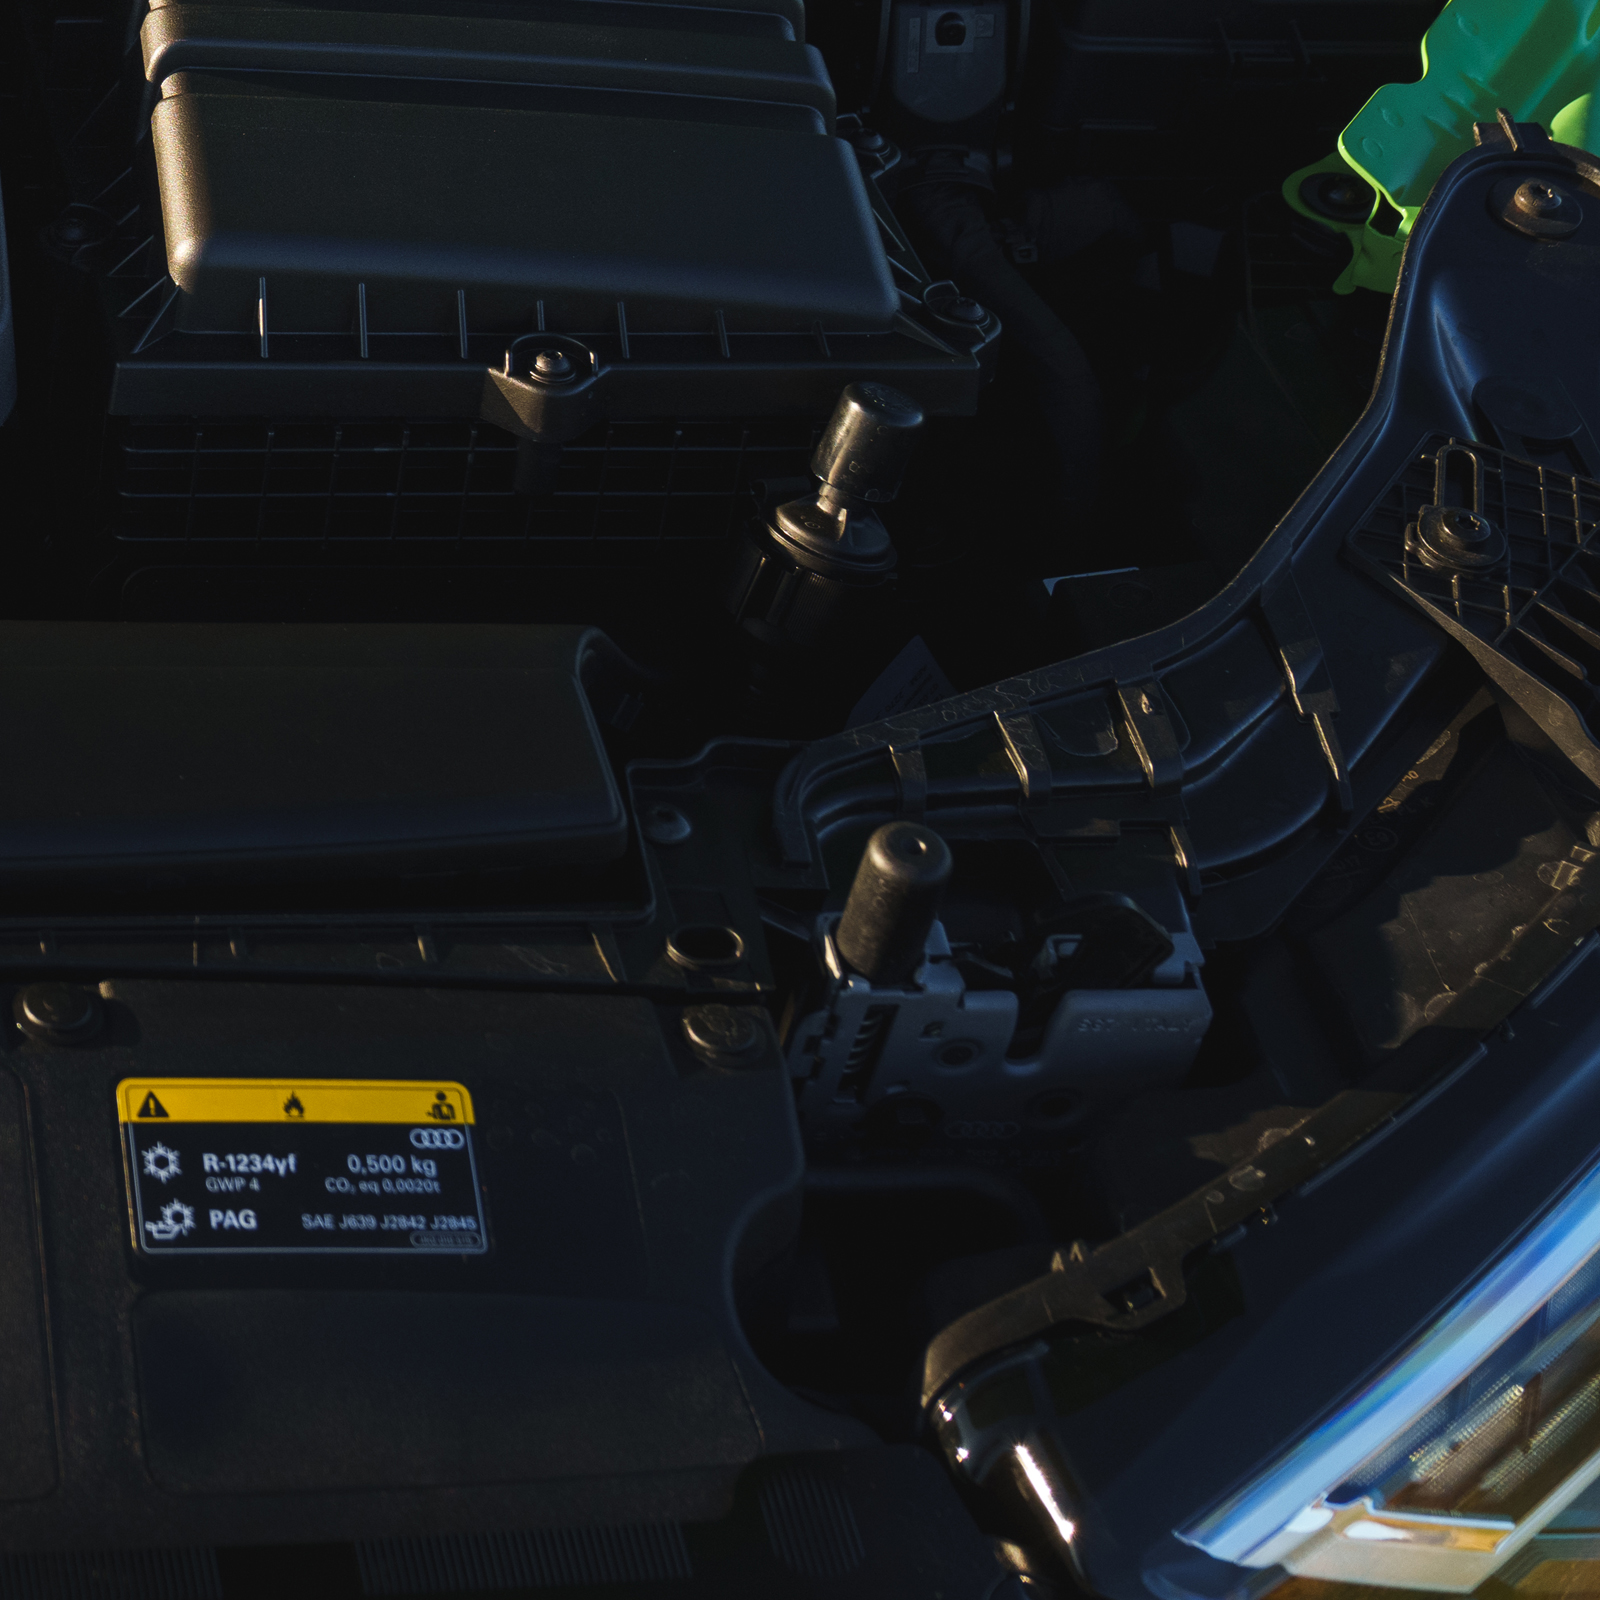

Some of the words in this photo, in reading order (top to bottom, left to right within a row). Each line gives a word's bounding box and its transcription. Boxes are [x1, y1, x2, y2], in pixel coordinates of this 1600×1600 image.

[202, 1152, 297, 1177] R-1234yf
[347, 1154, 405, 1176] 0,500
[411, 1154, 438, 1178] kg
[205, 1177, 245, 1192] GWP
[250, 1177, 260, 1192] 4
[209, 1209, 258, 1230] PAG
[301, 1213, 334, 1230] SAE
